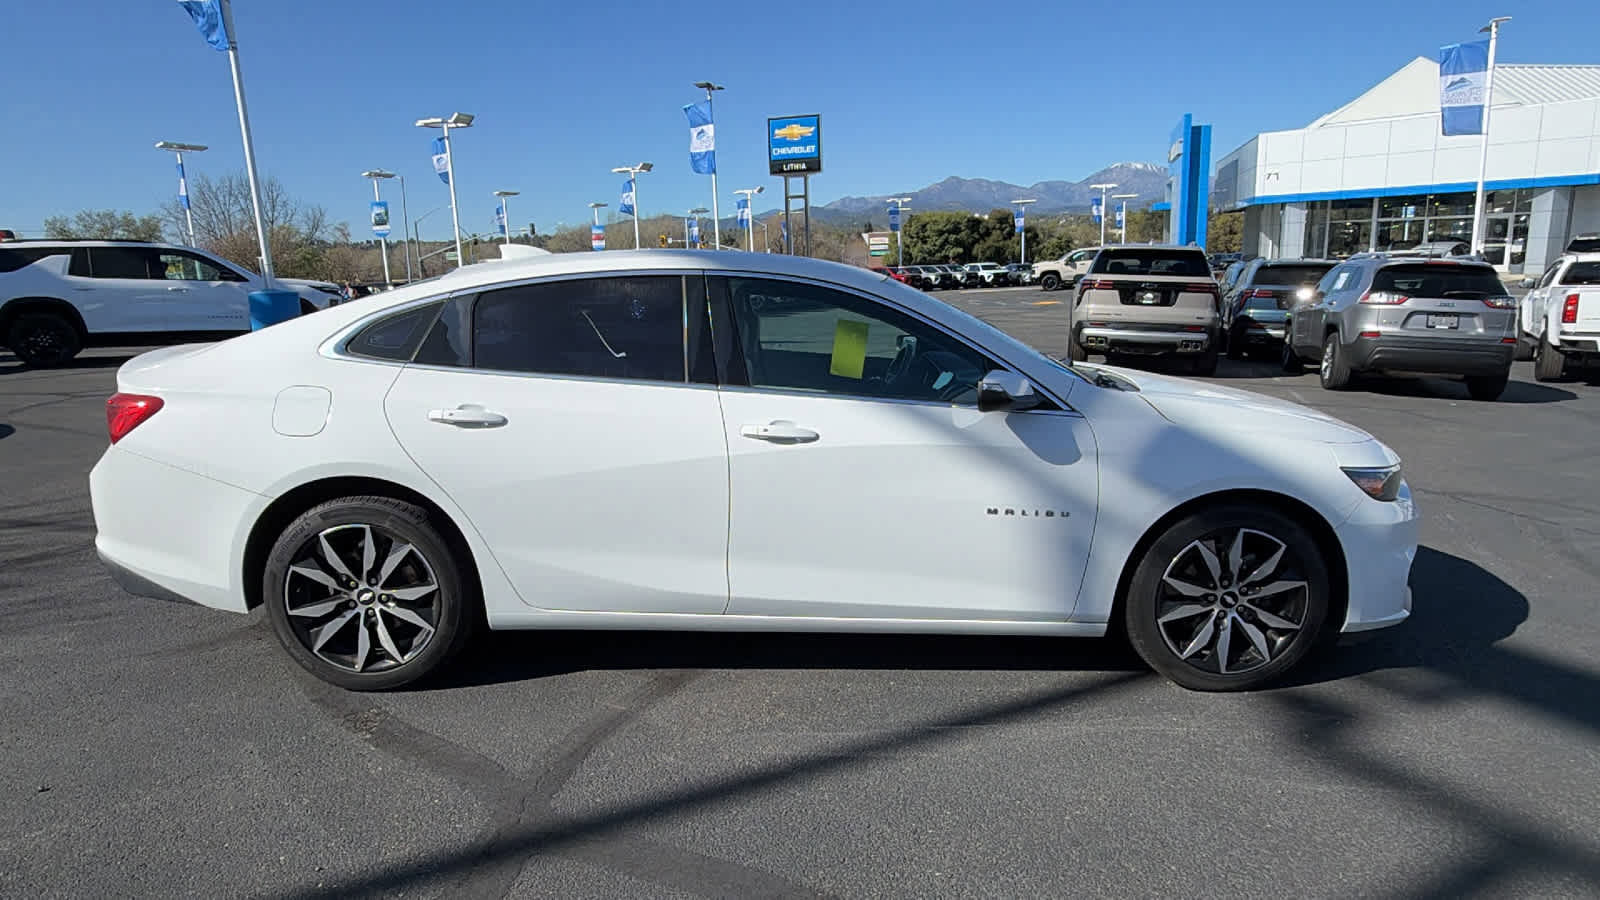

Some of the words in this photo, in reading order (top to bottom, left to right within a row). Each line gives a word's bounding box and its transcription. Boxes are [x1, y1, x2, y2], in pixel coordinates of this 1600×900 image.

[773, 145, 815, 155] CHEVROLET
[783, 163, 806, 171] LITHIA
[987, 508, 1070, 517] MALIBU
